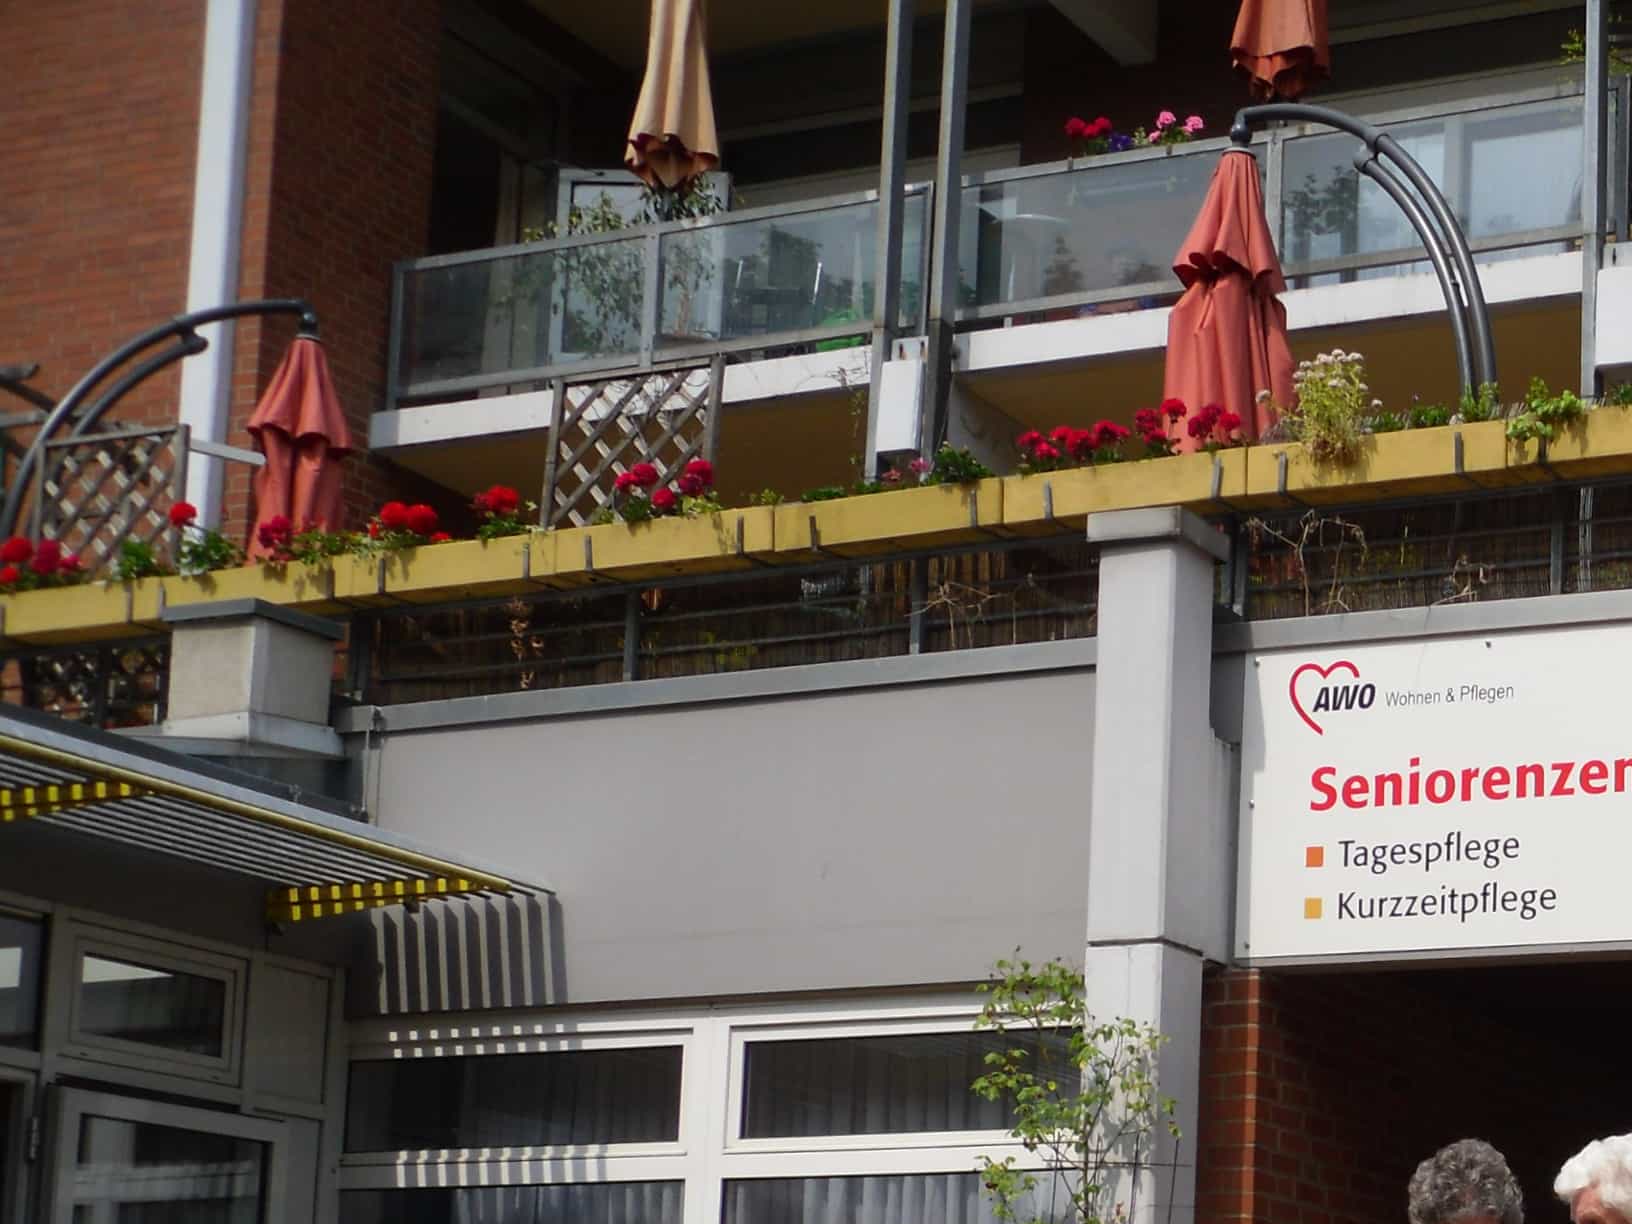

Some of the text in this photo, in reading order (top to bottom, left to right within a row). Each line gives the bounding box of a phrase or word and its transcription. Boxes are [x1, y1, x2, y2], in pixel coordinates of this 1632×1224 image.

[1312, 683, 1376, 713] AWO
[1385, 684, 1514, 707] Wohnen & Pflegen
[1338, 831, 1520, 875] Tagespflege
[1339, 881, 1557, 923] Kurzzeitpflege
